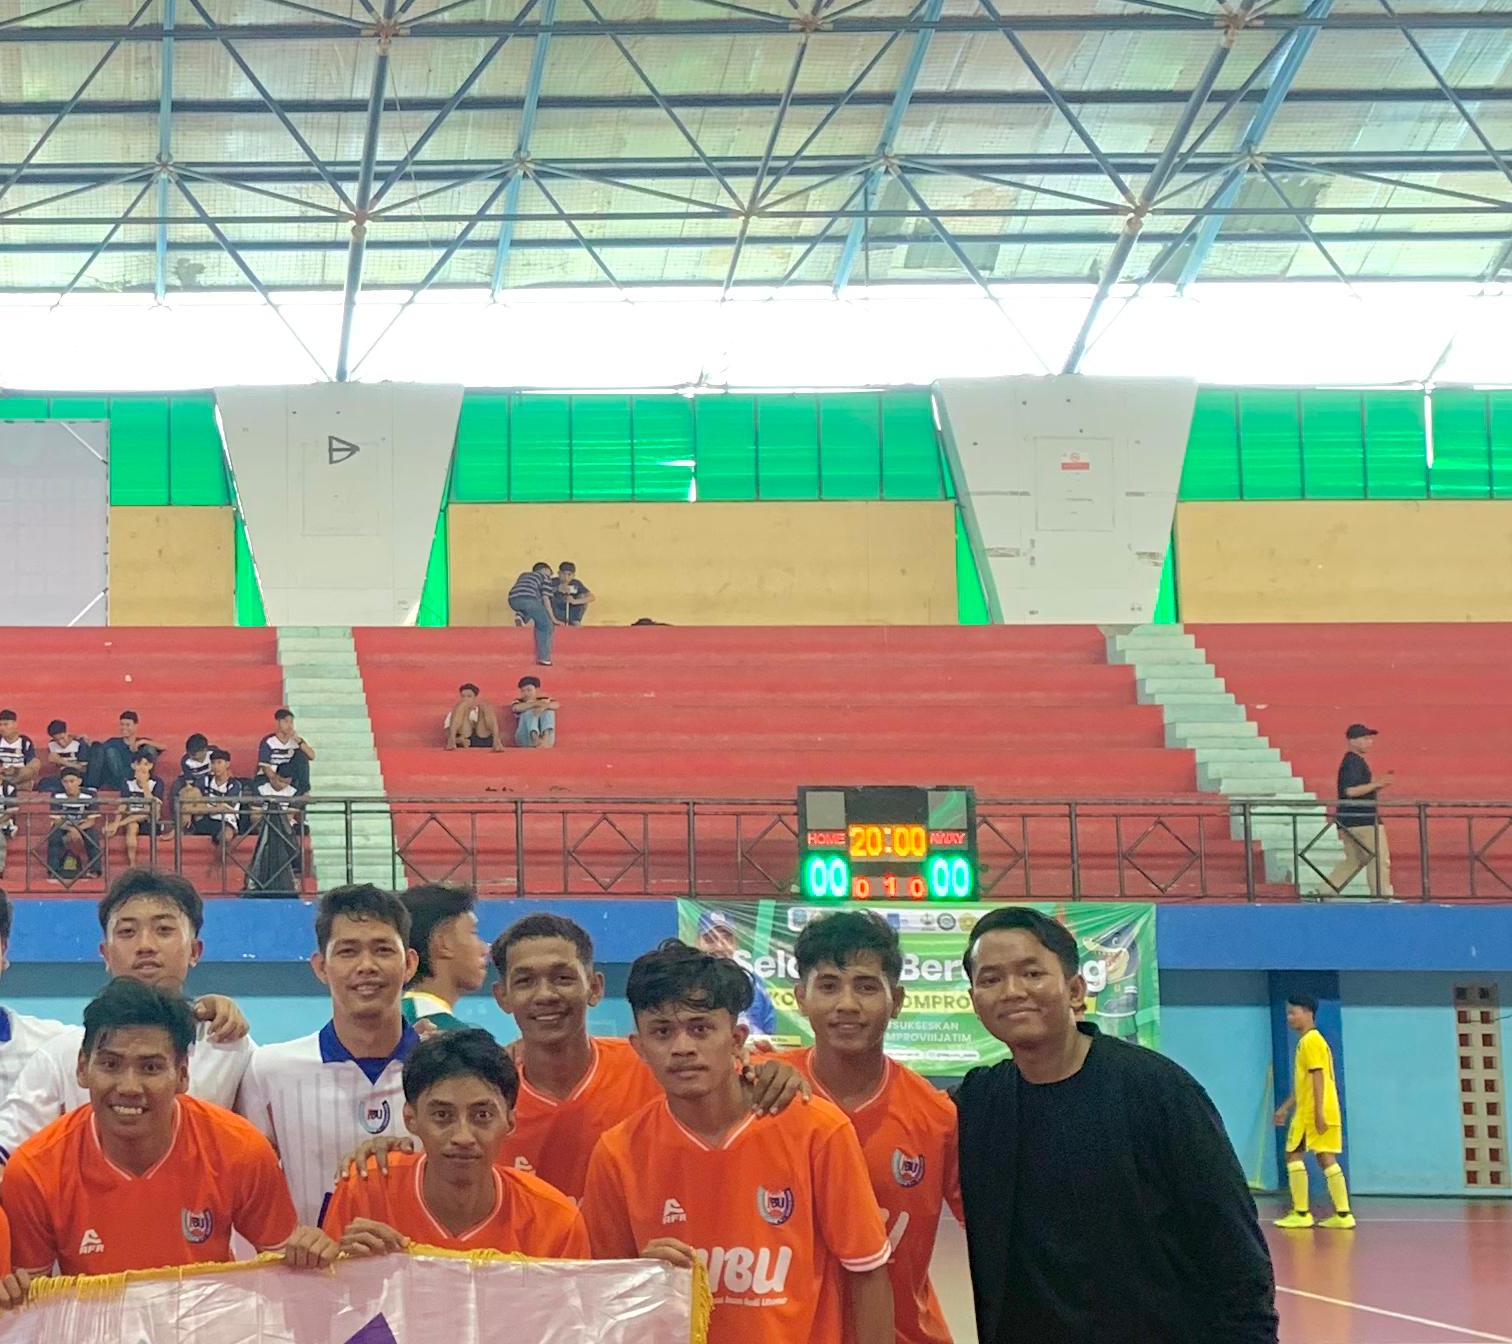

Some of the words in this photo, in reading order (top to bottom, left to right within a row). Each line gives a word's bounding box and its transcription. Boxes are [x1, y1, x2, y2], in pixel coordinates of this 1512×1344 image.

[807, 832, 845, 845] HOME
[849, 826, 927, 857] 20:00
[930, 832, 965, 845] AWAY
[810, 857, 849, 898] 00
[854, 876, 870, 899] 0
[884, 875, 897, 897] 1
[909, 877, 926, 899] 0
[932, 857, 971, 898] 00
